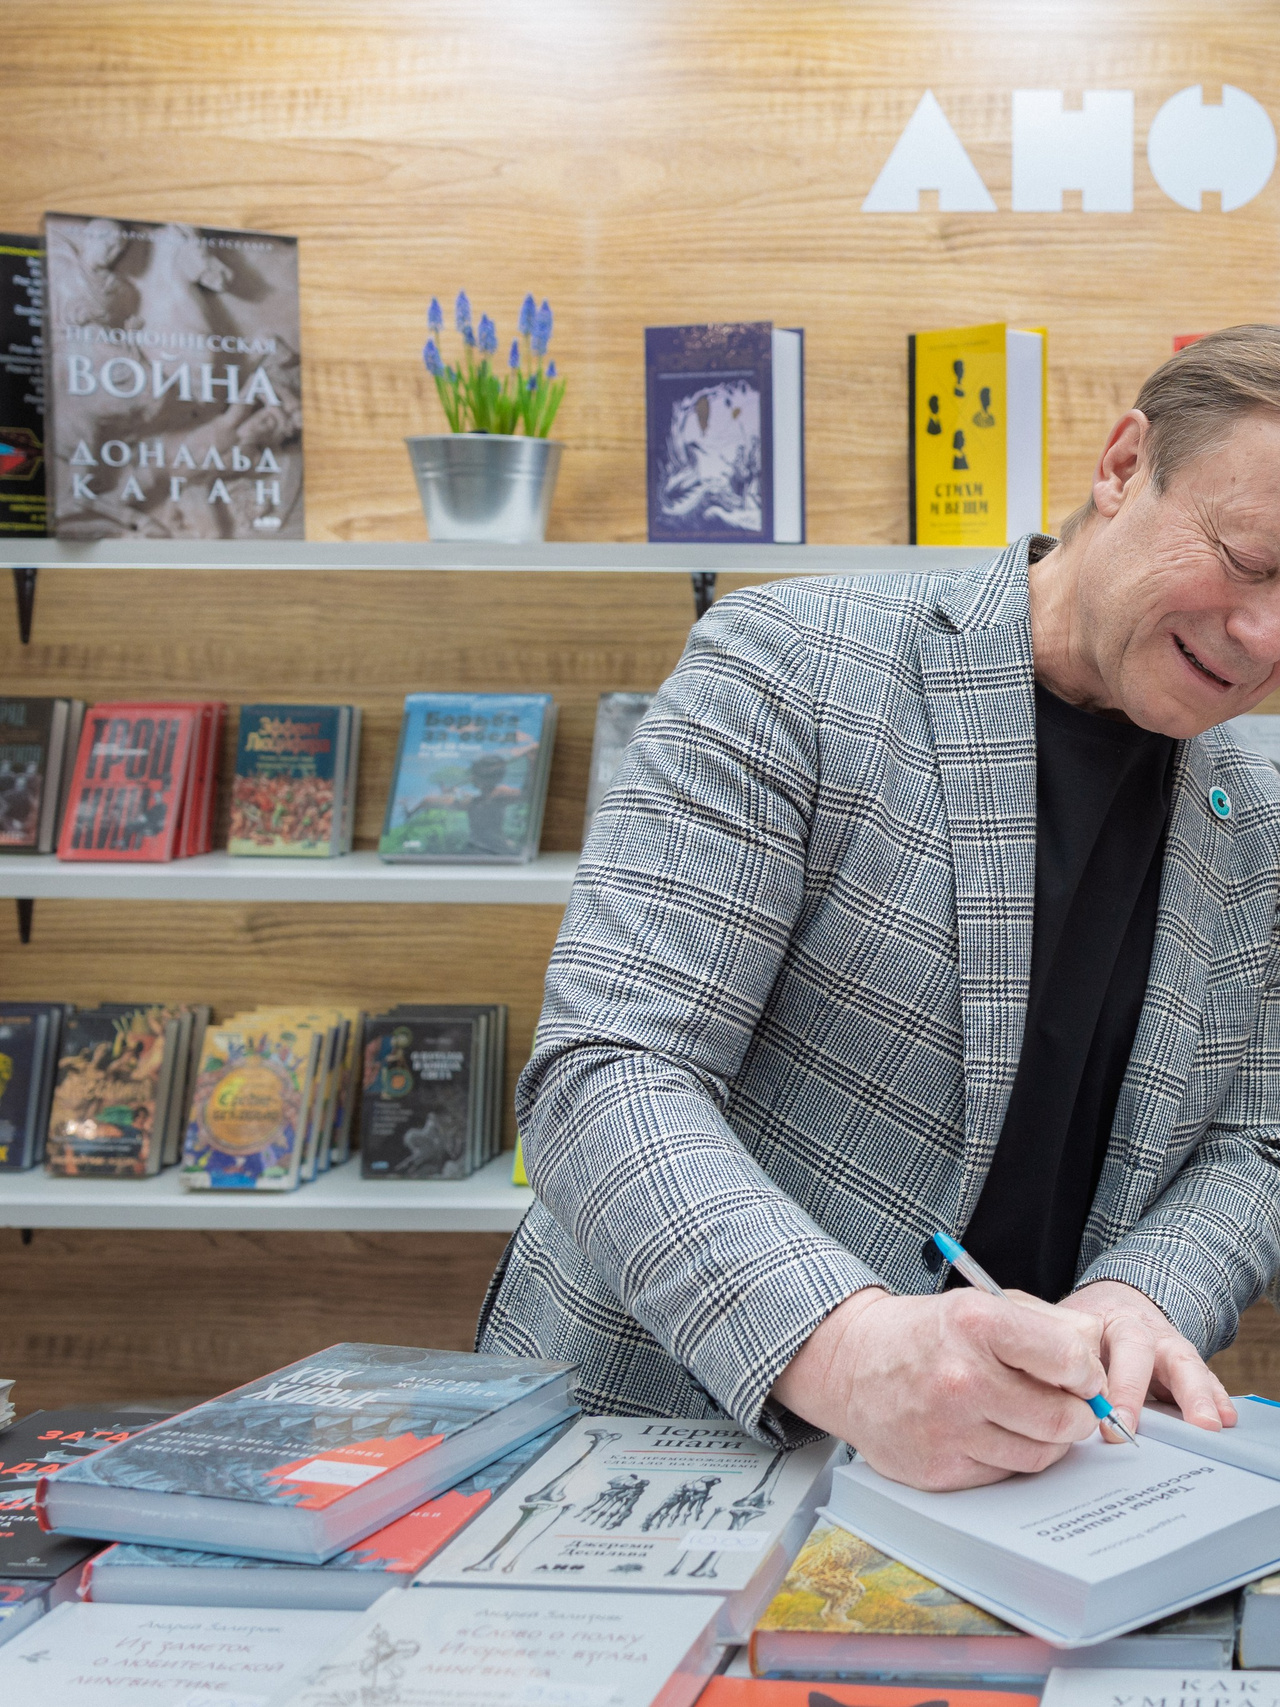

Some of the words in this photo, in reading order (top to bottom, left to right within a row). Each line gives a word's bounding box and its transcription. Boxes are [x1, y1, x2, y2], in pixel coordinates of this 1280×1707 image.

[66, 352, 282, 408] ВОЙНА
[69, 438, 282, 474] ДОНАЛЬД
[71, 473, 282, 506] КАГАН
[278, 1366, 364, 1387] КАК
[251, 1382, 392, 1411] ЖИВЫЕ
[37, 1430, 132, 1442] ЗАГА
[158, 1431, 232, 1443] ДВУНОГИЕ
[162, 1439, 214, 1450] ДРУГИЕ
[650, 1438, 746, 1450] шаги
[132, 1444, 210, 1456] ЖИВОТНЫЕ
[642, 1455, 761, 1464] ПРЯМОХОЖДЕНИЕ
[1036, 1465, 1216, 1538] бессознательного
[1129, 1485, 1196, 1511] Тайны
[1051, 1510, 1128, 1544] нашего
[565, 1540, 655, 1550] Джереми
[1180, 1678, 1263, 1692] КАК
